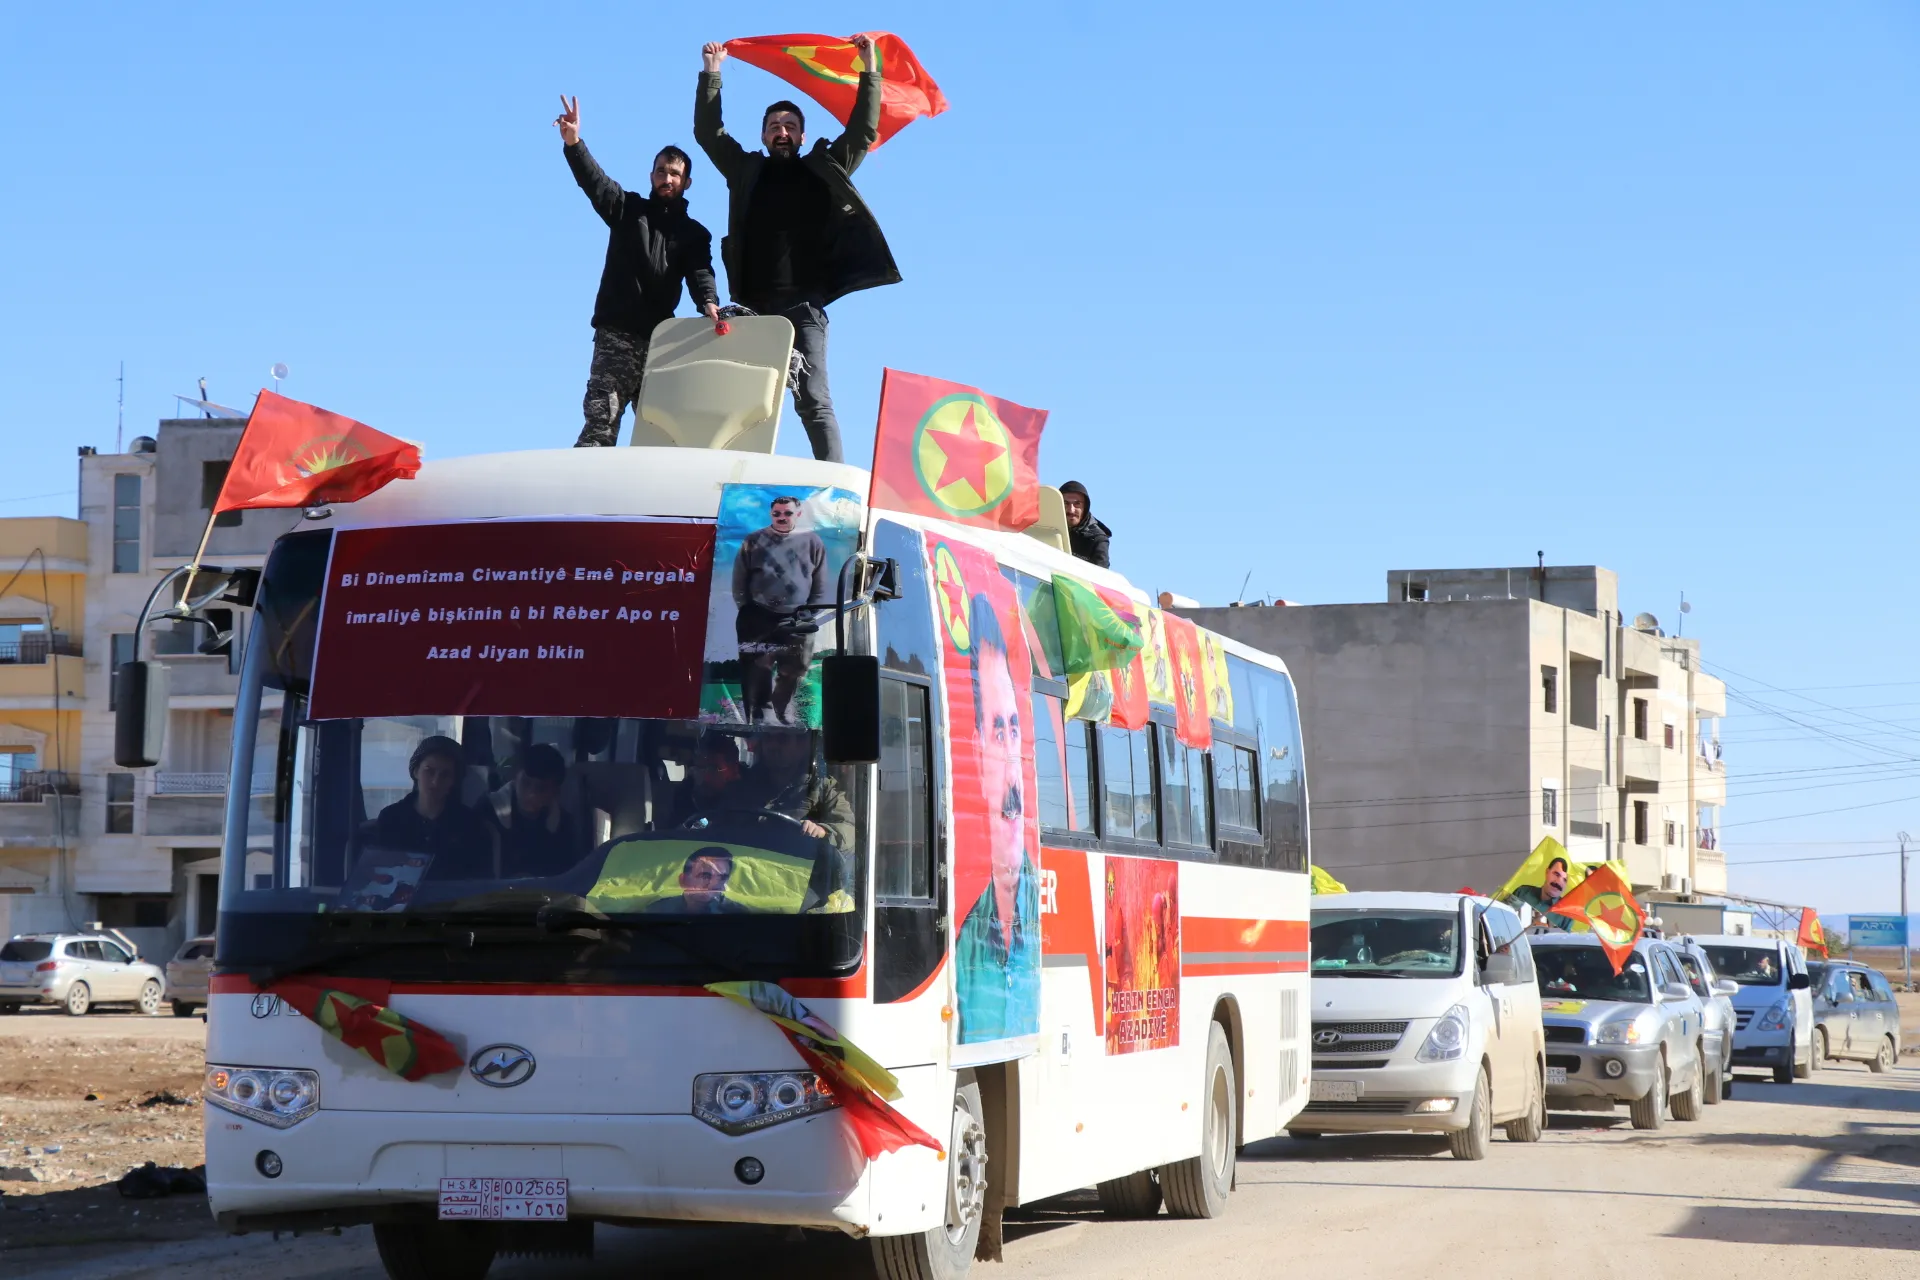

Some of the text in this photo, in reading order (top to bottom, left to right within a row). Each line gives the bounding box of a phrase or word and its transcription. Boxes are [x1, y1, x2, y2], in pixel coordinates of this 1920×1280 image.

[341, 567, 696, 587] Bi Dînemîzma Ciwantiyê Emê pergala
[346, 606, 680, 625] îmraliyê bişkînin û bi Rêber Apo re
[426, 645, 585, 662] Azad Jiyan bikin
[1860, 922, 1896, 931] ARTA
[504, 1181, 566, 1196] 002565
